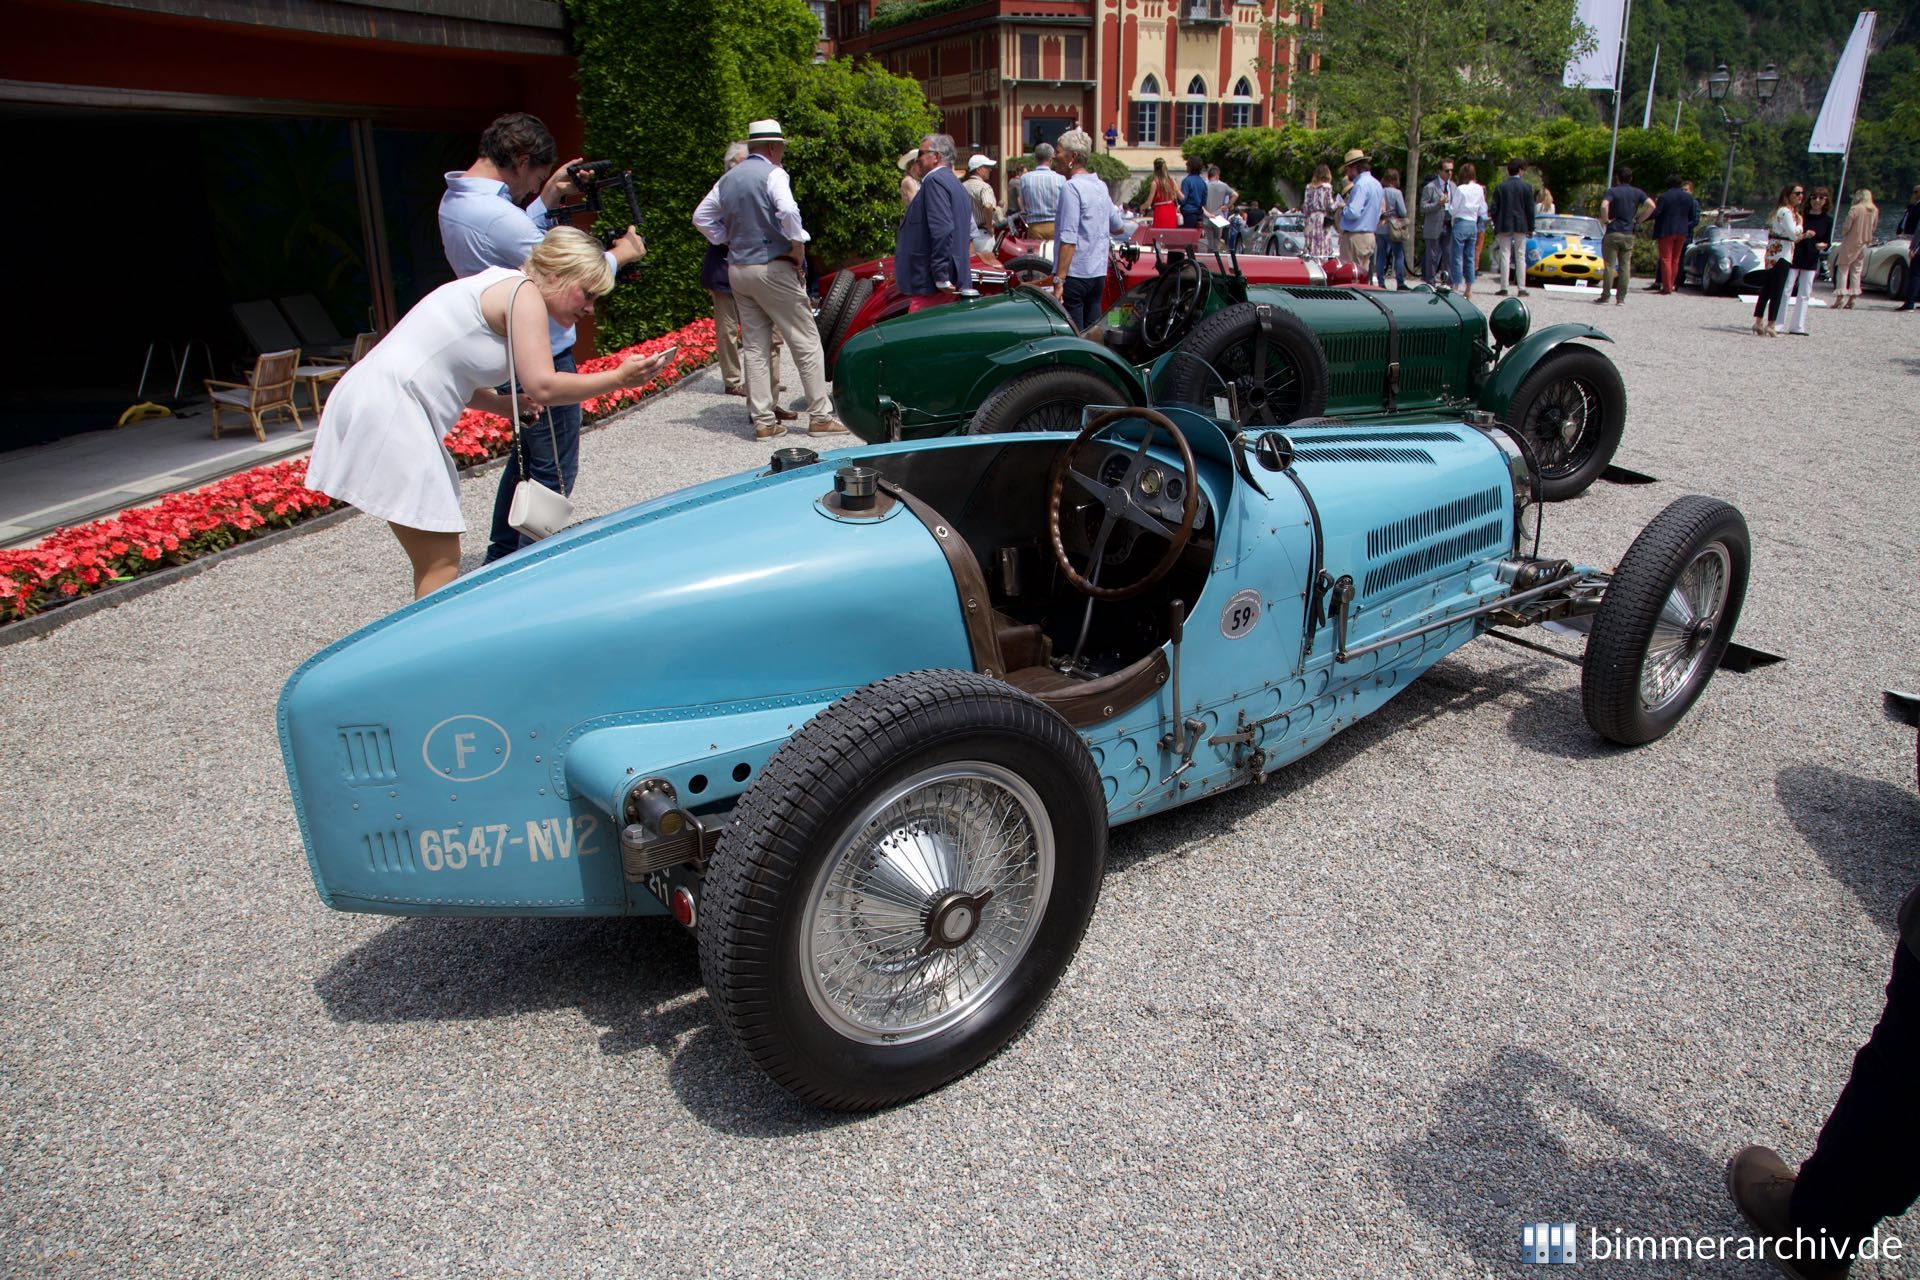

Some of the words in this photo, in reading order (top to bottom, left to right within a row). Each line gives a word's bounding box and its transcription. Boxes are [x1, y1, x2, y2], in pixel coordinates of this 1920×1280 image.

[1552, 243, 1596, 254] 112
[1231, 606, 1251, 631] 59
[454, 732, 477, 769] F
[419, 814, 600, 872] 6547-NV2
